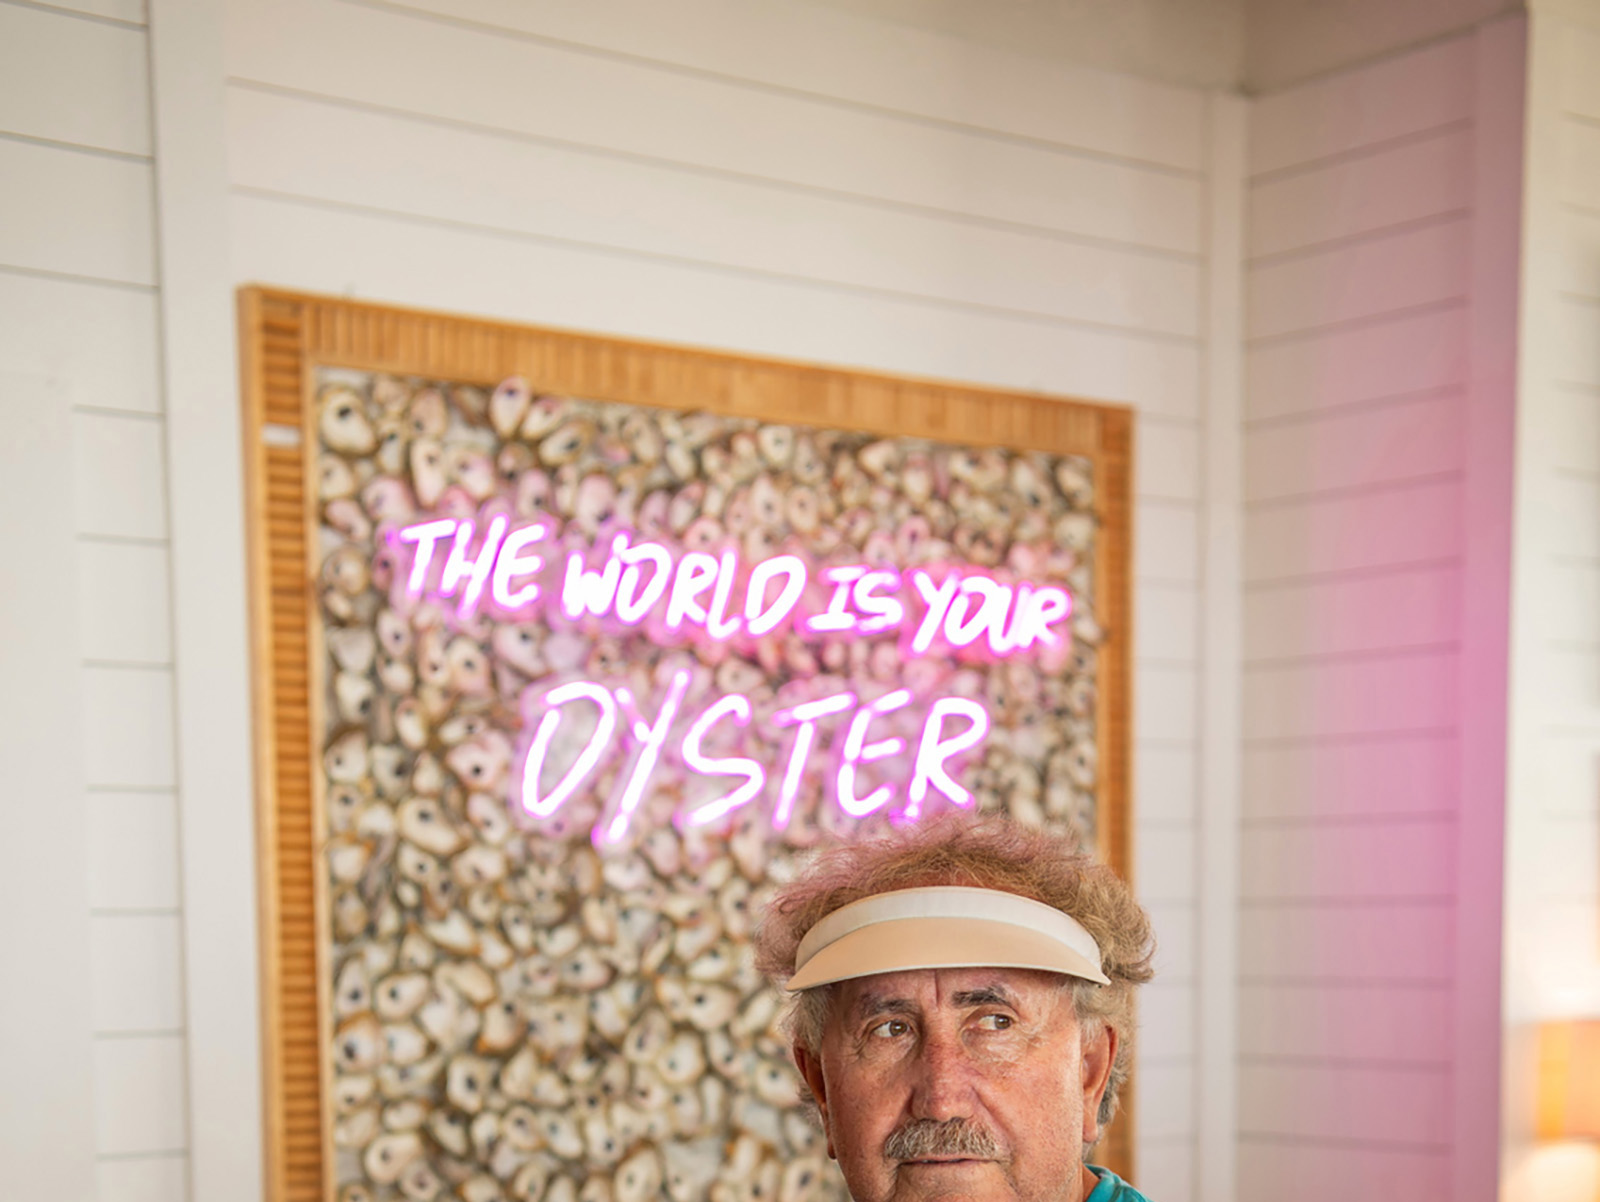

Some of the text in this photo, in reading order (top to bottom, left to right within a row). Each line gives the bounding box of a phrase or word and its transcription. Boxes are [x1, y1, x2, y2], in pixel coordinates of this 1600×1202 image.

[398, 514, 1072, 655] THE WORLD IS YOUR
[520, 669, 990, 844] OYSTER
